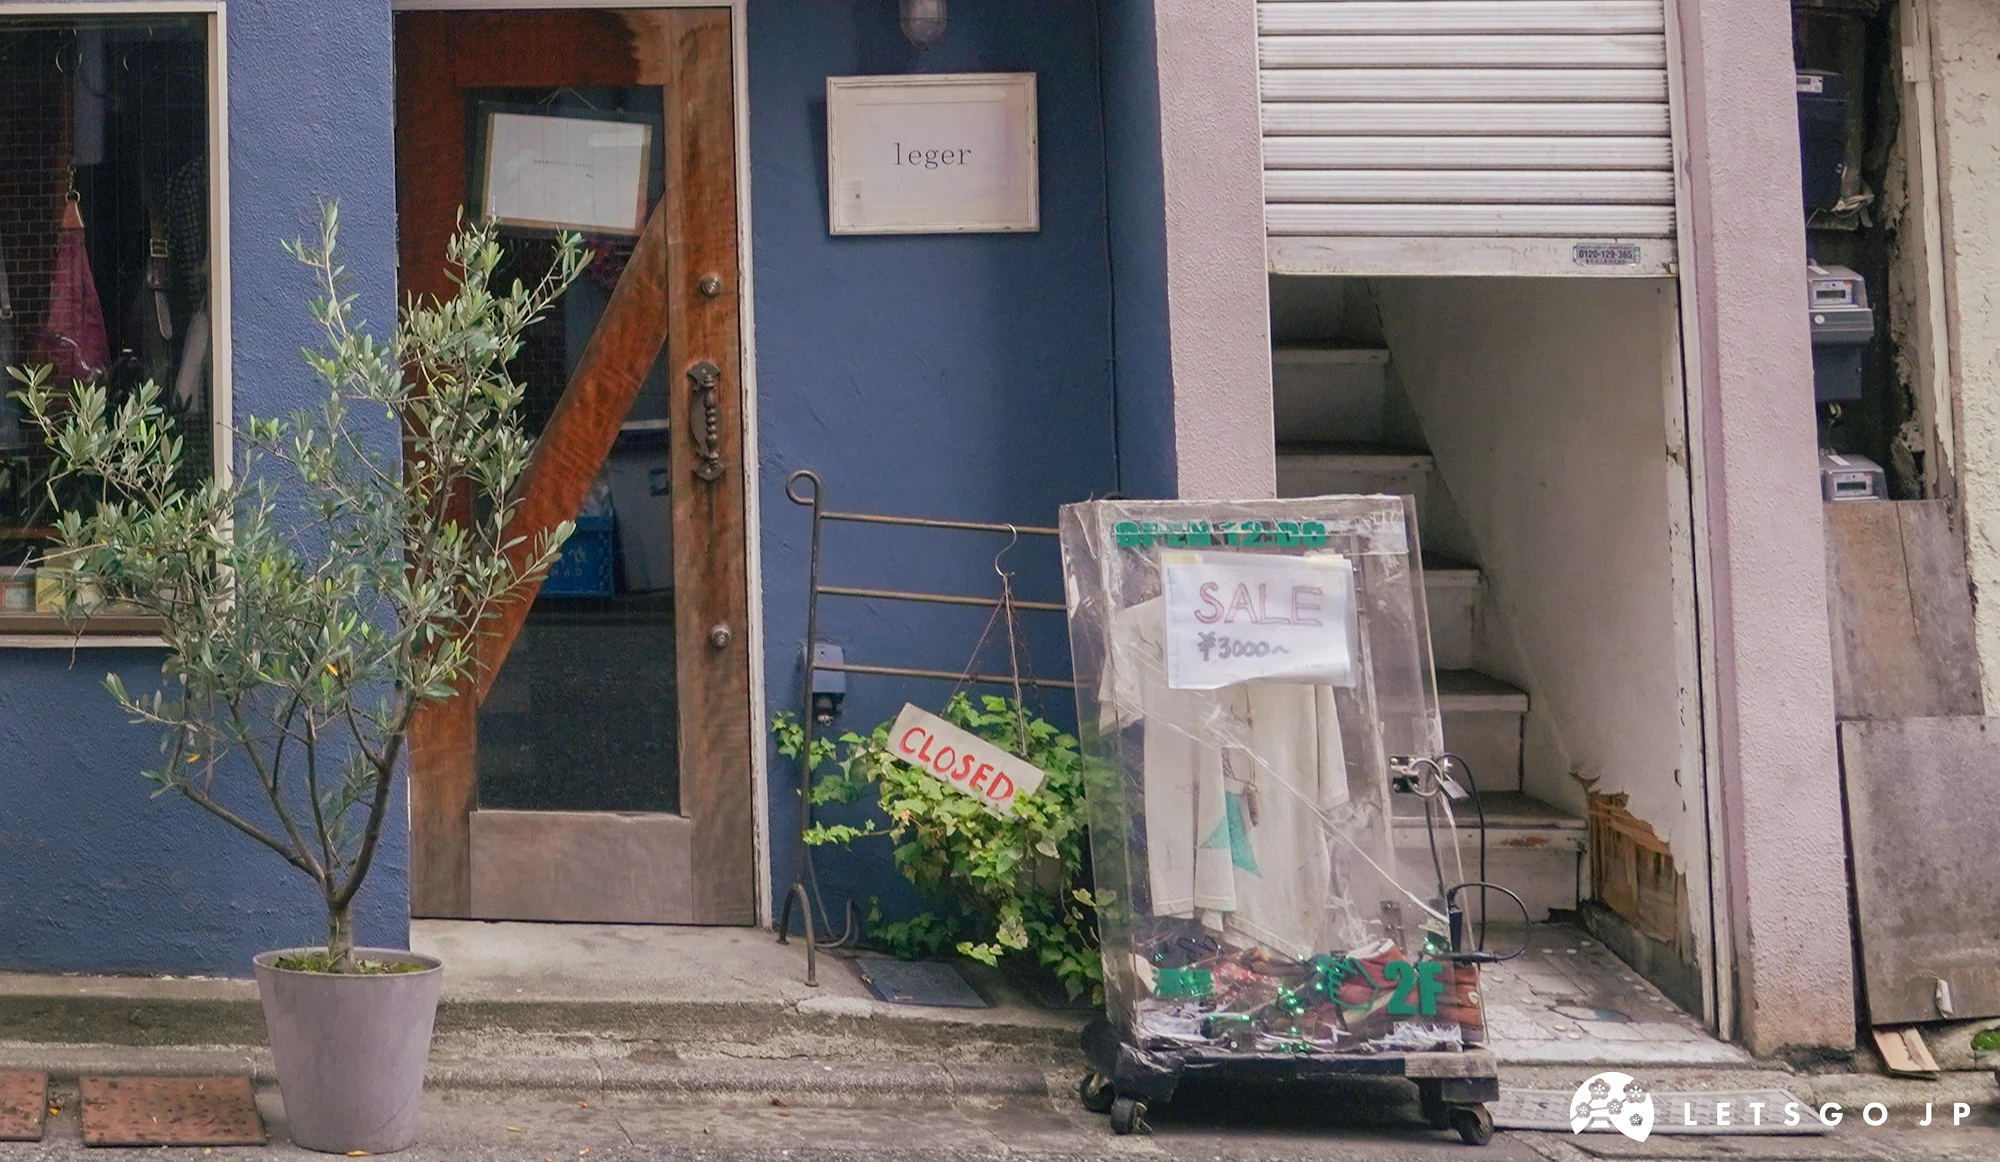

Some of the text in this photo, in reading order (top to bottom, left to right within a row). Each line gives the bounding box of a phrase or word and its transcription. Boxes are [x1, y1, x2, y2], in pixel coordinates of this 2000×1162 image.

[894, 142, 972, 170] leger
[1114, 521, 1212, 548] OPEN
[1193, 581, 1323, 627] SALE
[898, 726, 1014, 801] CLOSED
[1385, 960, 1444, 1015] 2F
